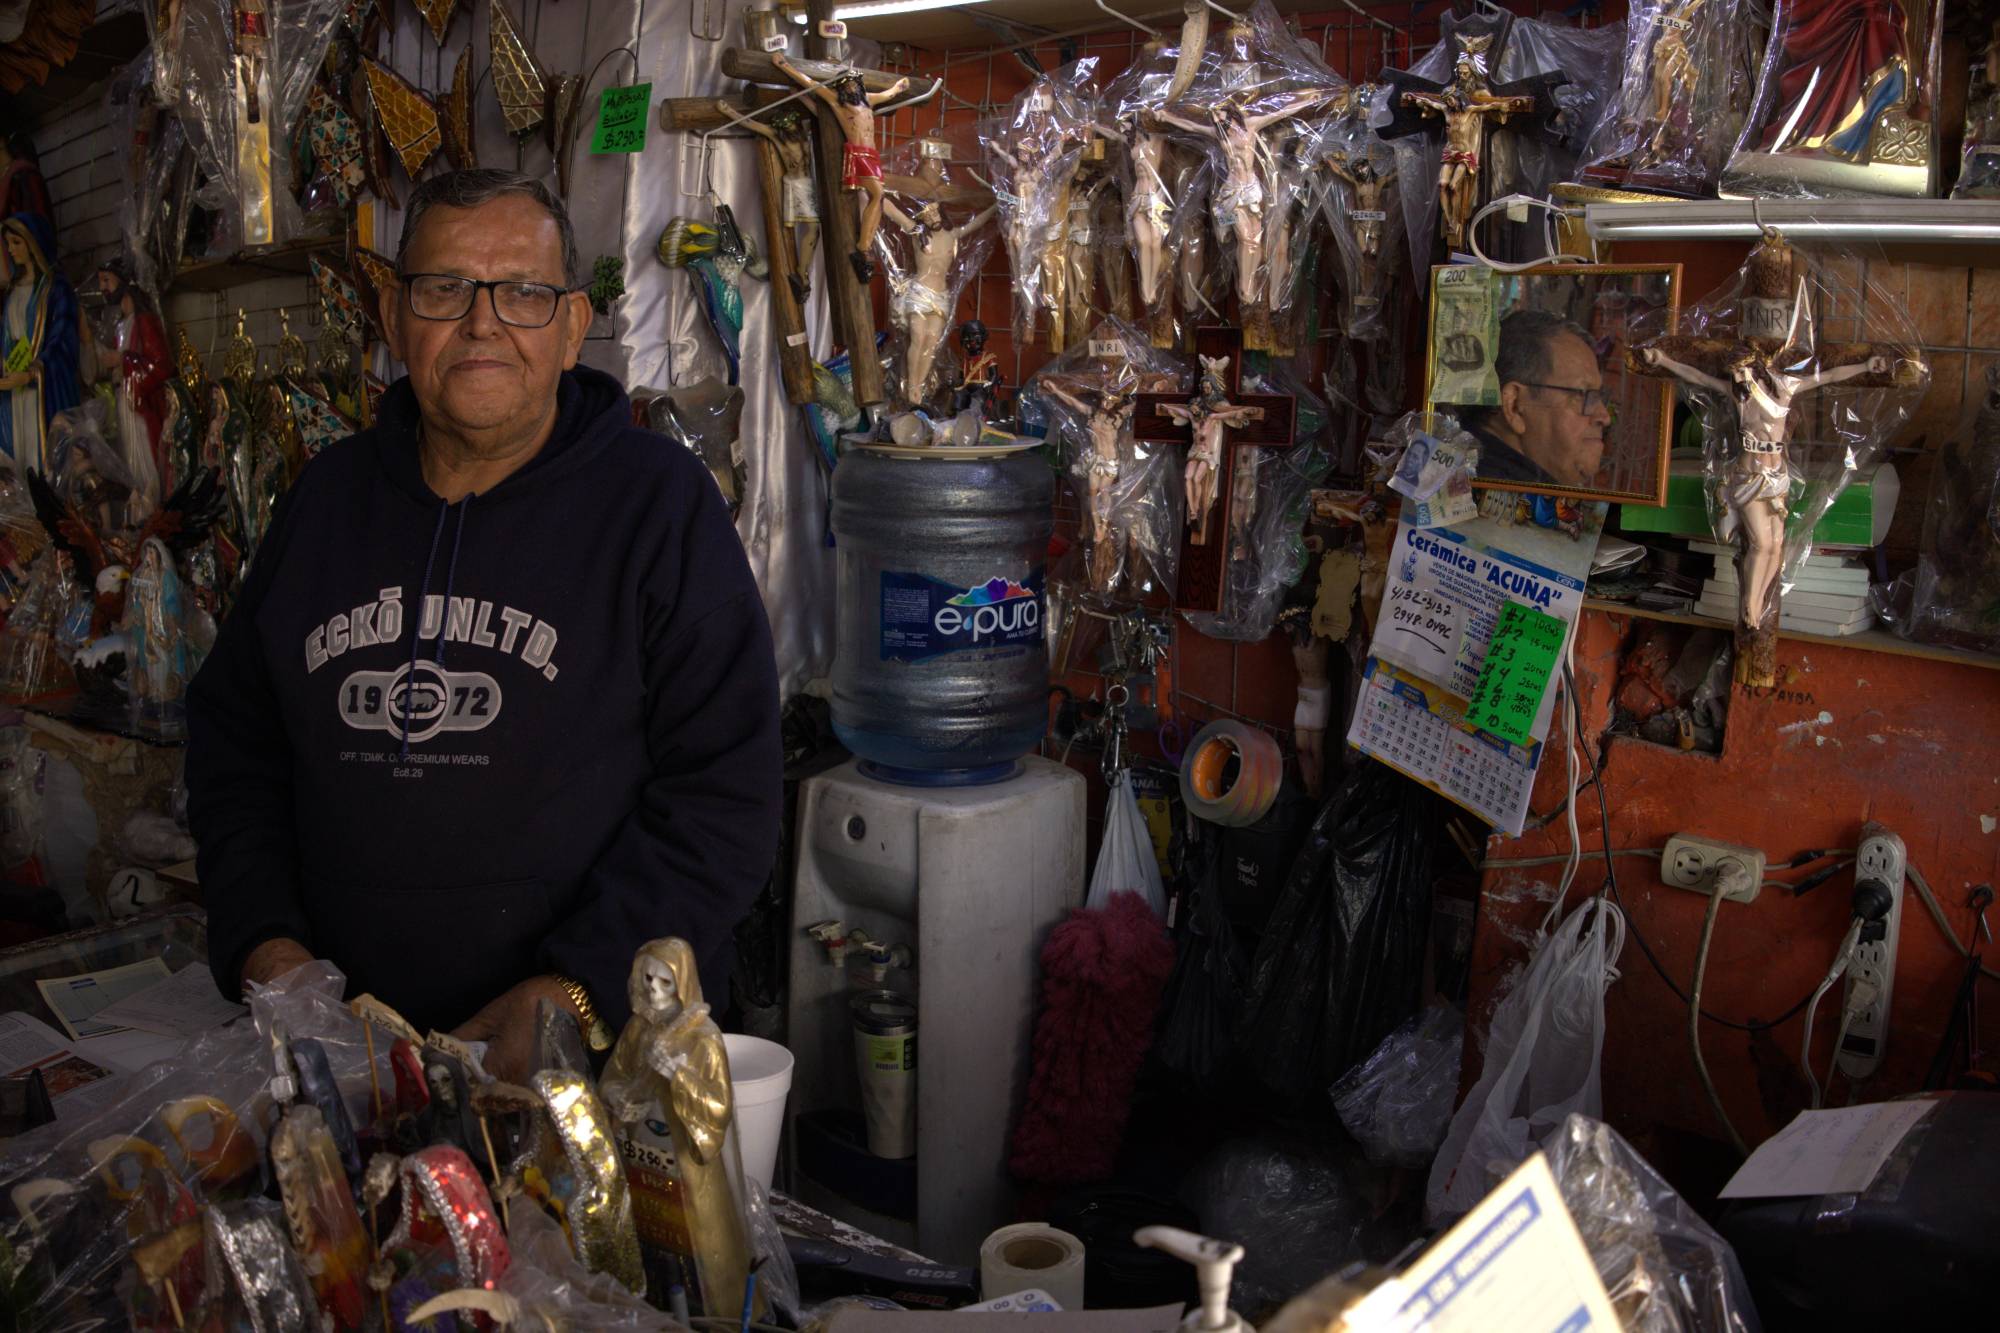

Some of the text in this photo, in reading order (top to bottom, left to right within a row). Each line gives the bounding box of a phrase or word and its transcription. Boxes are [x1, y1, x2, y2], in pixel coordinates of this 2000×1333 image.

[1445, 269, 1466, 283] 200
[1095, 343, 1118, 353] INRI
[1432, 449, 1455, 468] 500
[1407, 529, 1476, 574] Cerámica
[418, 594, 560, 682] UNLTD.
[403, 753, 449, 764] PREMIUM
[451, 754, 490, 765] WEARS
